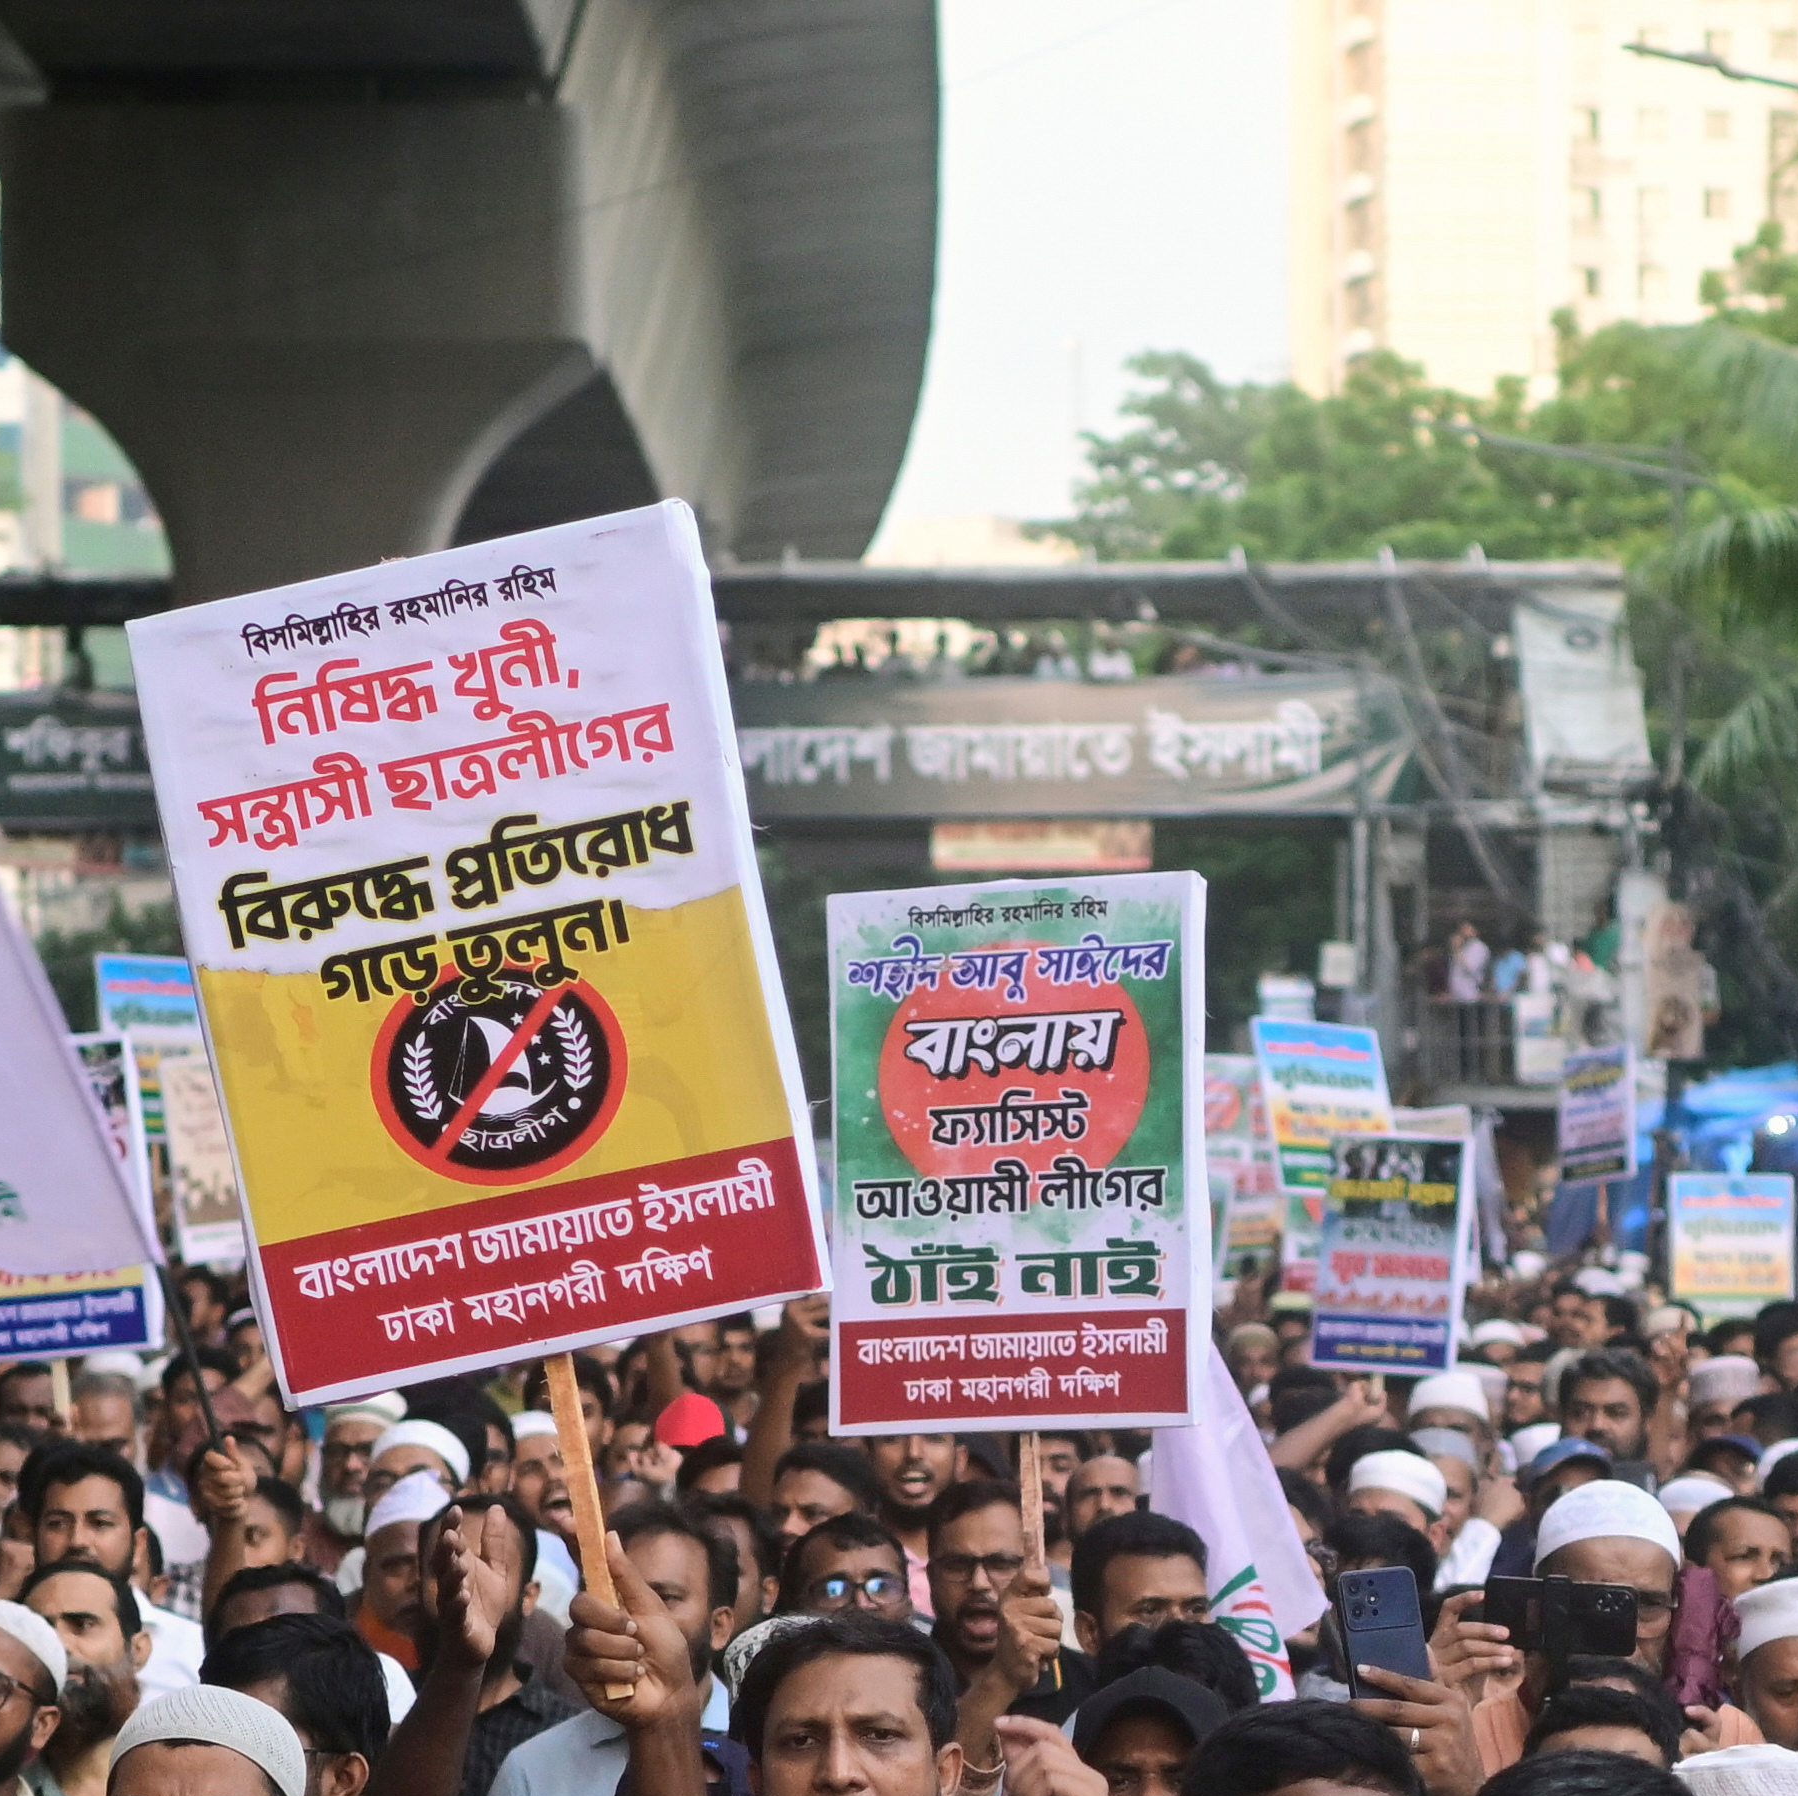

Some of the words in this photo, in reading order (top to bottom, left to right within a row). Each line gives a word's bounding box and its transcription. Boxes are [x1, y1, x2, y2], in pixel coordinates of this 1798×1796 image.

[243, 601, 381, 658] বিসমিল্লাহির
[386, 578, 489, 627] রহমানির
[497, 566, 558, 603] রহিম
[252, 656, 438, 746] নিষিদ্ধ
[448, 617, 582, 721] খুনী,
[197, 750, 375, 851] সন্ত্রাসী
[382, 700, 674, 812] ছাত্রলীগের
[741, 721, 894, 787] লাদেশ
[905, 719, 1137, 782] জামায়াতে
[1145, 699, 1330, 782] ইসলামী
[219, 853, 436, 950] বিরুদ্ধে
[446, 798, 695, 913] প্রতিরোধ
[908, 905, 994, 931] বিসমিল্লাহির
[1002, 898, 1065, 923] রহমানির
[1071, 895, 1109, 917] রহিম
[321, 937, 442, 1005] গড়ে
[448, 896, 632, 1004] তুলুন।
[951, 945, 1030, 1001] আবু
[1037, 934, 1173, 985] সাঈদের
[904, 1008, 1126, 1081] বাংলায়
[459, 1105, 569, 1153] ছাত্রলীগ
[930, 1088, 1091, 1147] ফ্যাসিস্ট
[854, 1157, 1031, 1220] আওয়ামী
[1039, 1155, 1168, 1212] লীগের
[294, 1233, 467, 1301] বাংলাদেশ
[472, 1198, 633, 1269] জামায়াতে
[643, 1159, 777, 1233] ইসলামী
[378, 1297, 455, 1343] ঢাকা
[463, 1264, 608, 1328] মহানগরী
[616, 1244, 714, 1302] দক্ষিণ
[864, 1243, 1005, 1306] ঠাঁই
[1016, 1237, 1166, 1300] নাই
[857, 1332, 966, 1366] বাংলাদেশ
[971, 1329, 1078, 1363] জামায়াতে
[1081, 1320, 1169, 1358] ইসলামী
[904, 1377, 952, 1403] ঢাকা
[960, 1371, 1051, 1403] মহানগরী
[1058, 1368, 1122, 1400] দক্ষিণ
